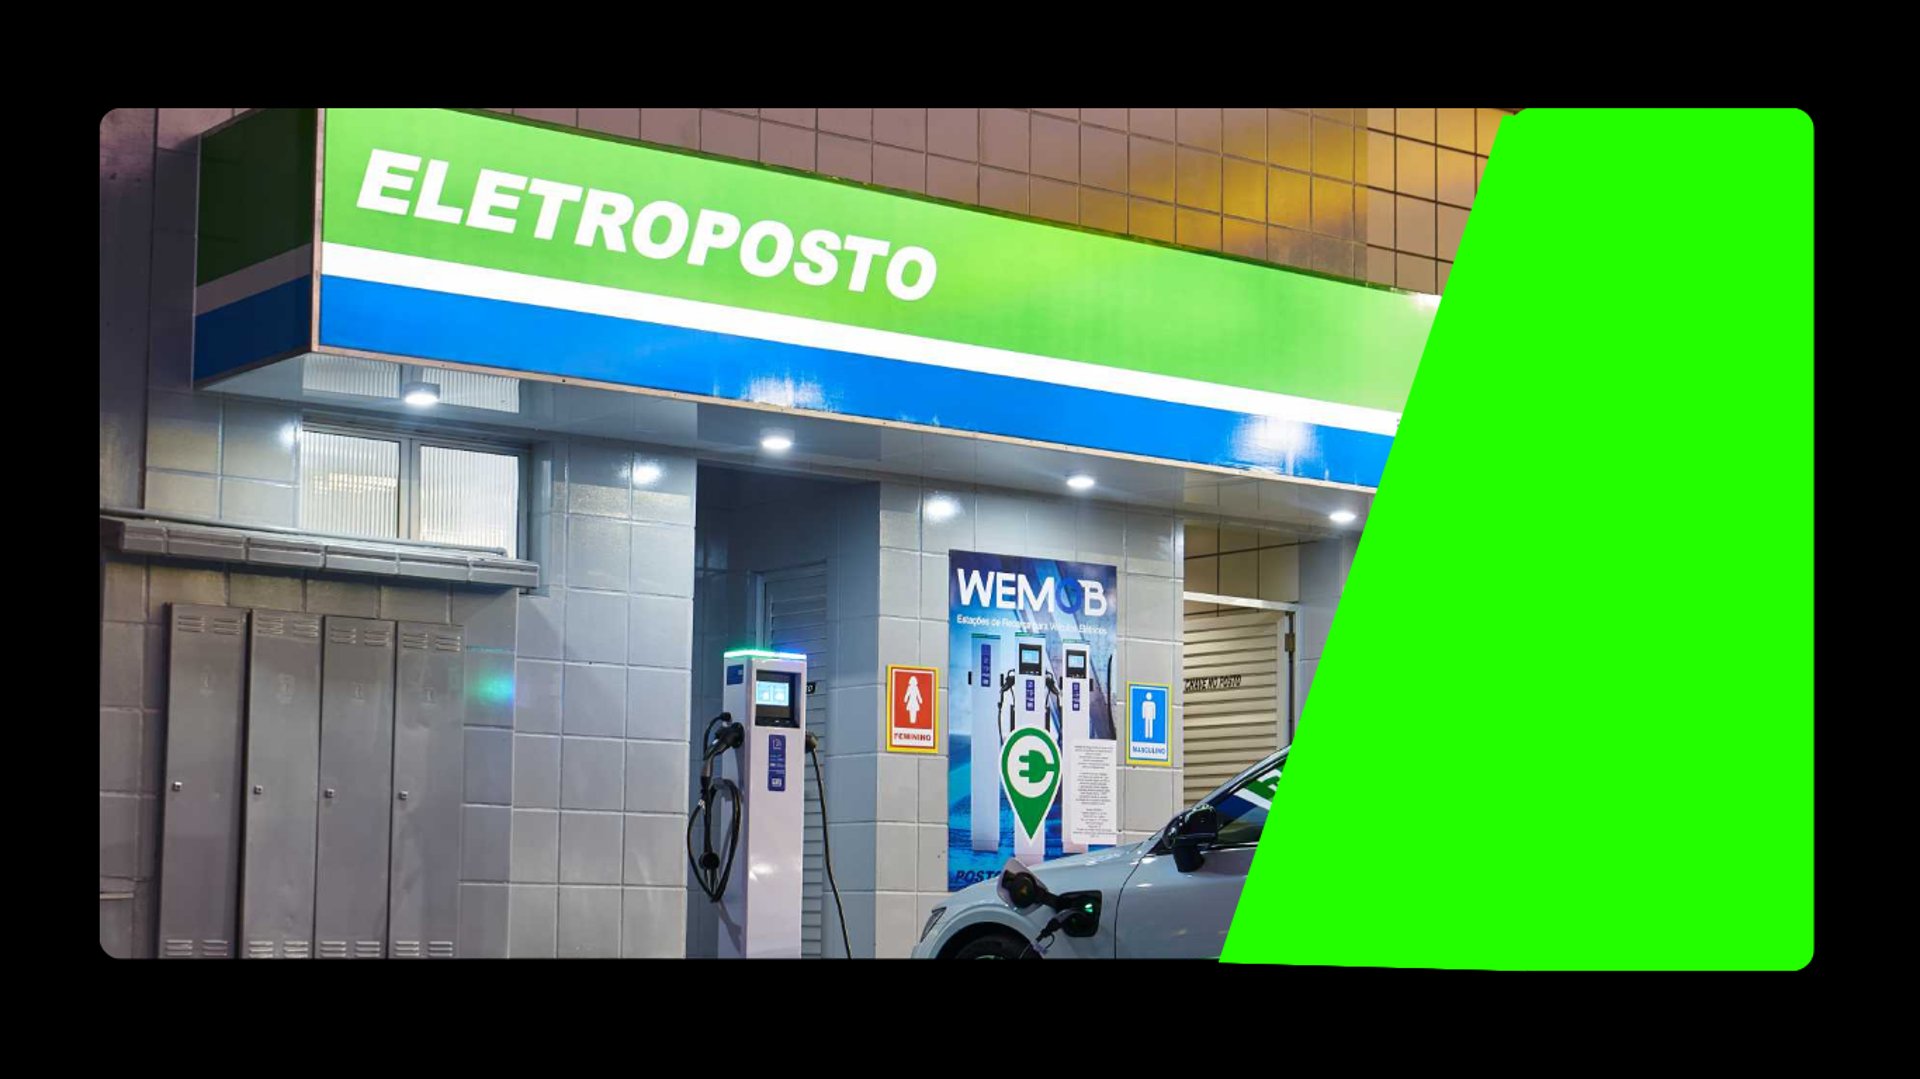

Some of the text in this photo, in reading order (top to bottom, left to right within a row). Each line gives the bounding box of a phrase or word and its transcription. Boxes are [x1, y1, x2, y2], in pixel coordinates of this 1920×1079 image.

[356, 148, 937, 301] ELETROPOSTO
[957, 568, 1107, 616] WEMOB
[894, 732, 931, 741] FEMININO
[1132, 745, 1166, 755] MASCULINO
